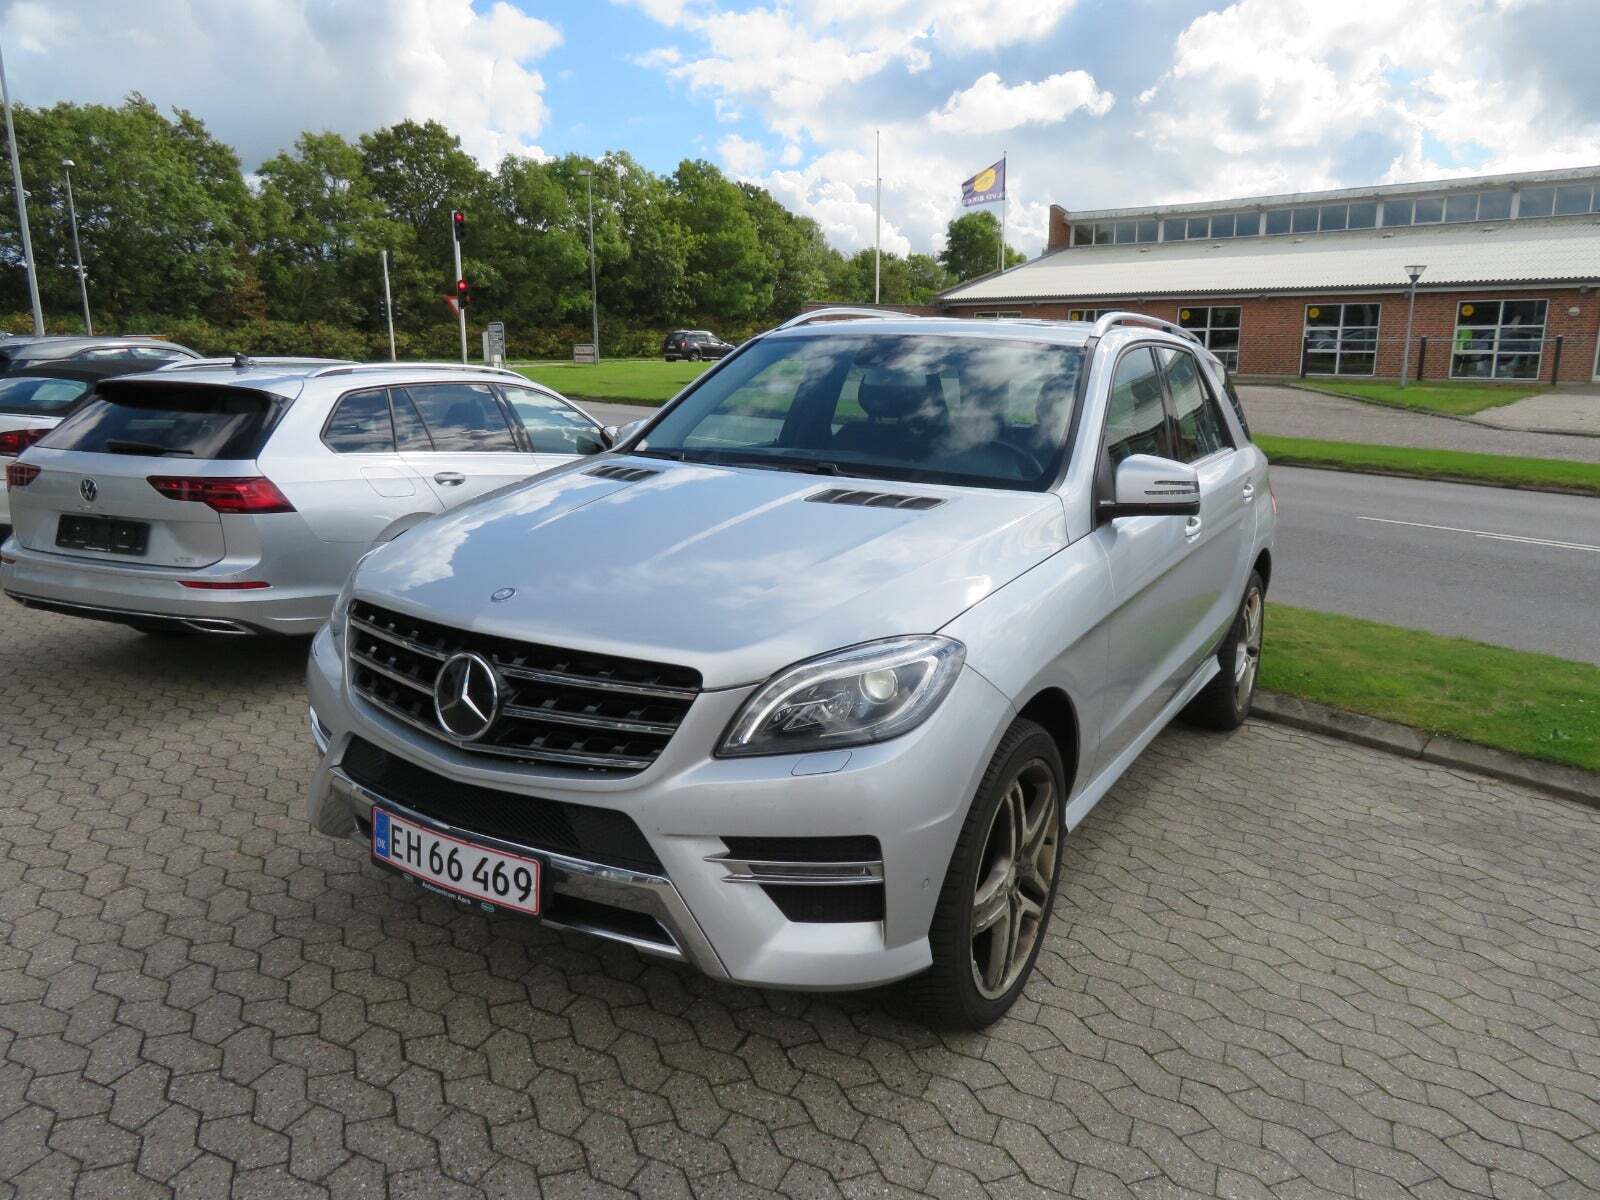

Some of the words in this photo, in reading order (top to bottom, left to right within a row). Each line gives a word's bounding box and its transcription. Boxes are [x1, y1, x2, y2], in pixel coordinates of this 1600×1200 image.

[377, 837, 386, 849] DK
[391, 824, 421, 867] EH
[429, 841, 463, 882] 66
[472, 857, 532, 902] 469
